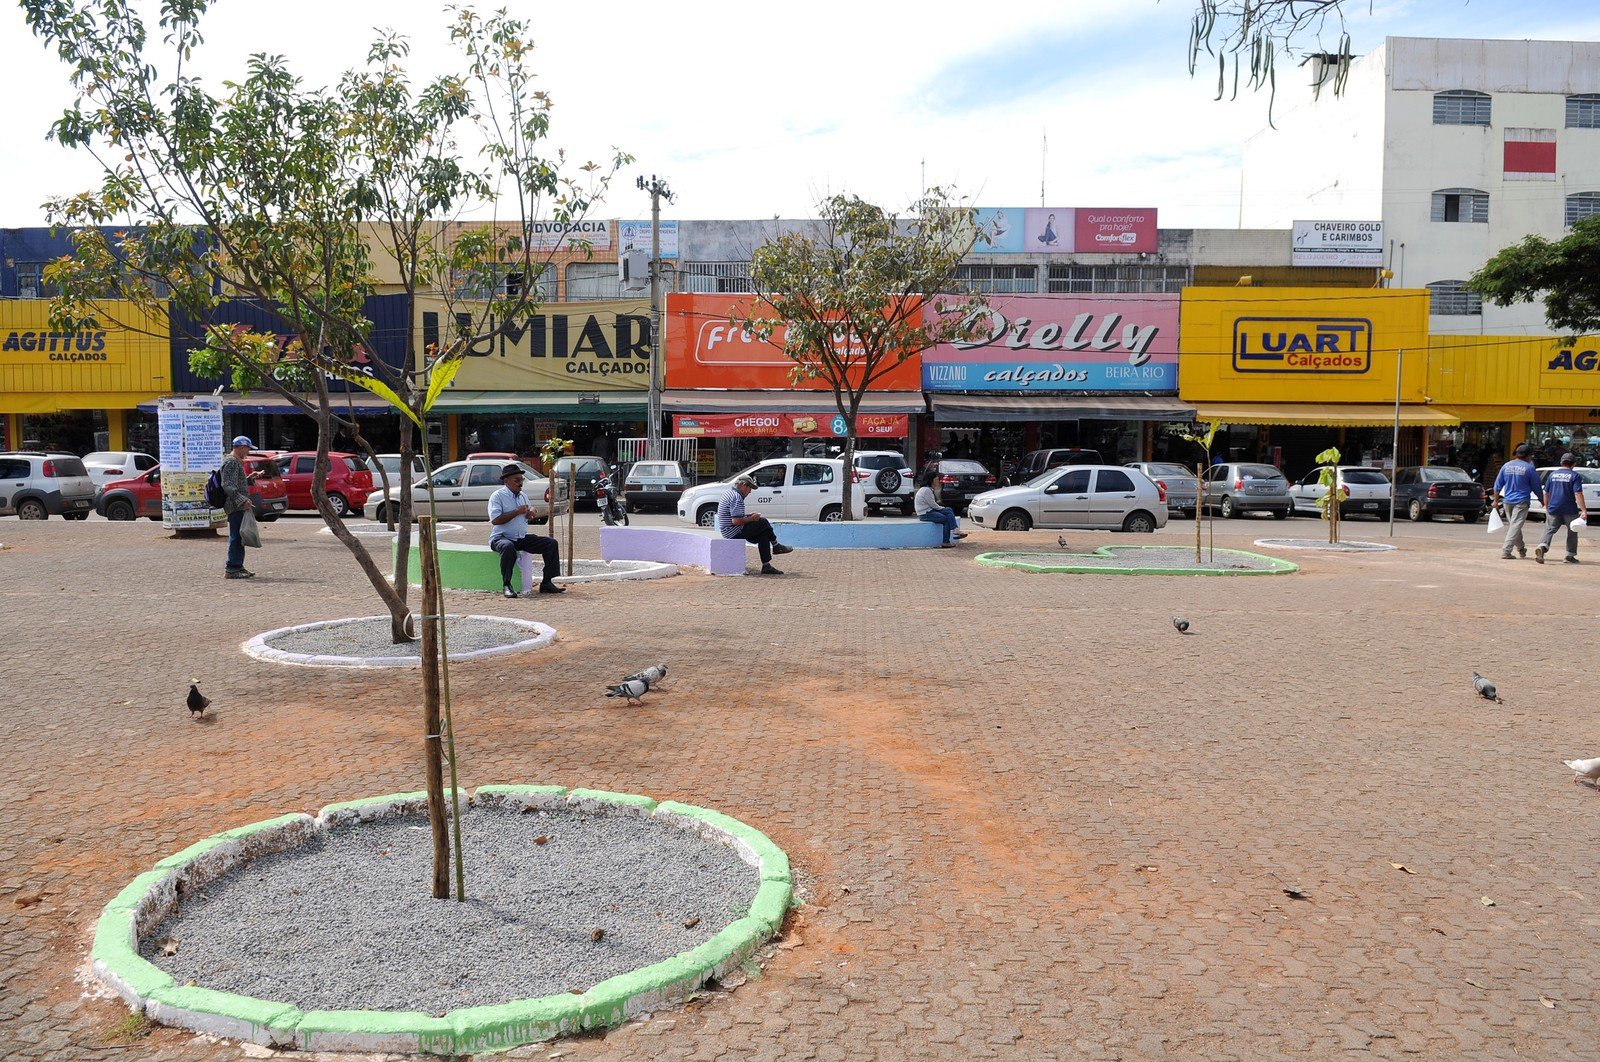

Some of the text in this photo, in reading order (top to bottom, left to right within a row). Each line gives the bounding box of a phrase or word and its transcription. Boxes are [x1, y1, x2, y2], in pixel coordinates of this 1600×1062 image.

[1088, 214, 1105, 223] Qual
[1113, 215, 1145, 223] conforto
[526, 222, 606, 233] ADVOCACIA
[1113, 223, 1133, 231] hoje?
[1314, 223, 1381, 231] CHAVEIRO GOLD
[1095, 234, 1135, 243] Comfortflex
[1322, 233, 1373, 241] E CARIMBOS
[423, 311, 651, 360] LUMIAR
[938, 303, 1159, 367] Dielly
[3, 332, 106, 352] AGITTUS
[1241, 325, 1364, 360] LUART
[49, 353, 107, 363] CALÇADOS
[1287, 352, 1362, 368] Calçados
[1548, 350, 1600, 371] AG
[929, 366, 967, 381] VIZZANO
[983, 363, 1088, 385] calçados
[1105, 367, 1164, 378] BEIRA RIO
[734, 418, 780, 427] CHEGOU
[862, 416, 885, 427] FAÇA
